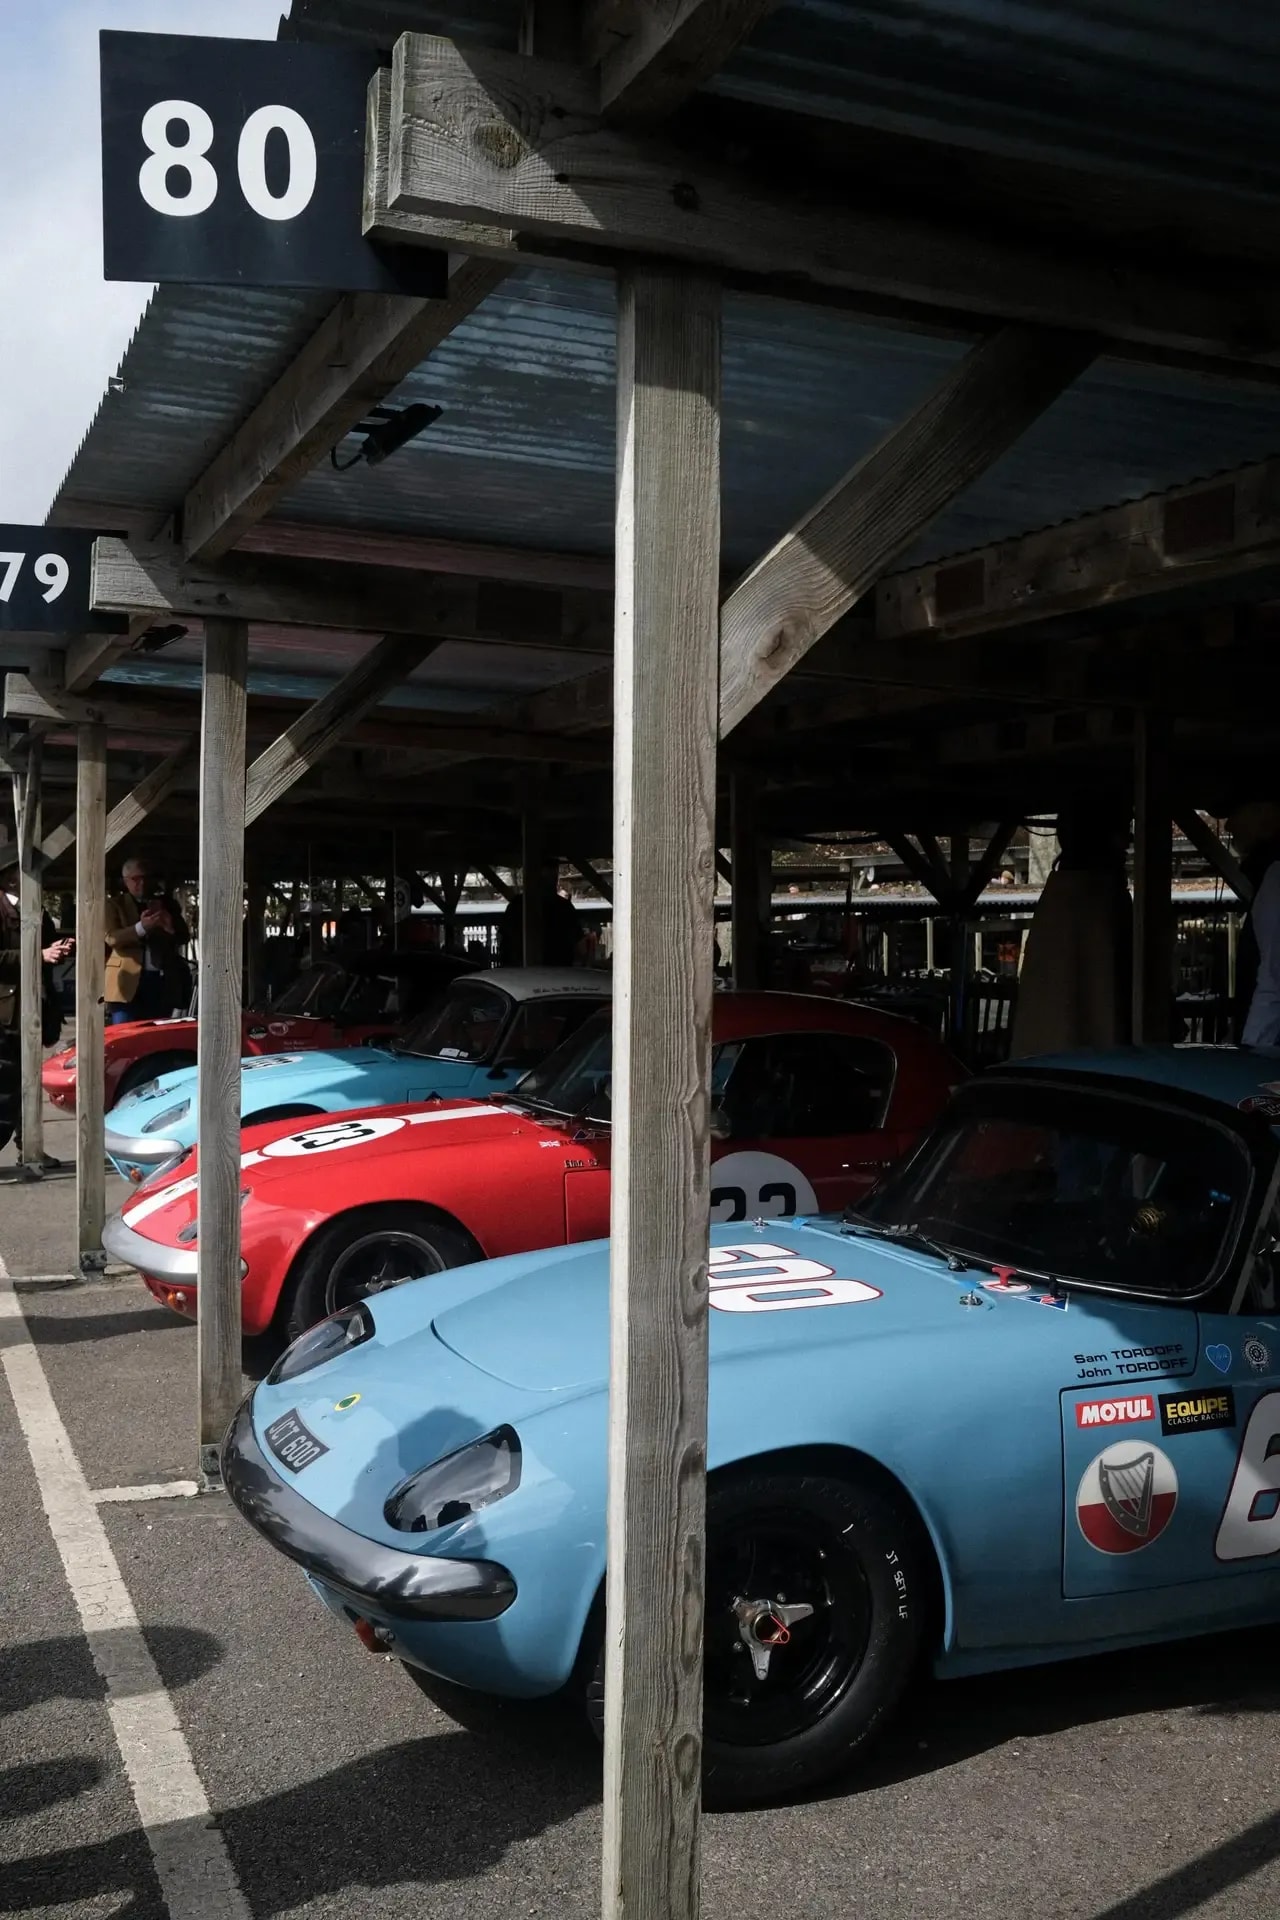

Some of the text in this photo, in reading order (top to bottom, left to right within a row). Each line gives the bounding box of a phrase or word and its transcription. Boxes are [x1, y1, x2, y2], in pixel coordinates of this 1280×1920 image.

[138, 99, 318, 221] 80
[0, 552, 70, 604] 79
[289, 1122, 376, 1150] 23
[1074, 1344, 1184, 1364] Sam TORDOFF
[1077, 1357, 1189, 1379] John TORDOFF
[1080, 1398, 1152, 1425] MOTUL
[1167, 1411, 1229, 1426] CLASSIC RACING
[269, 1416, 321, 1468] JCT 600
